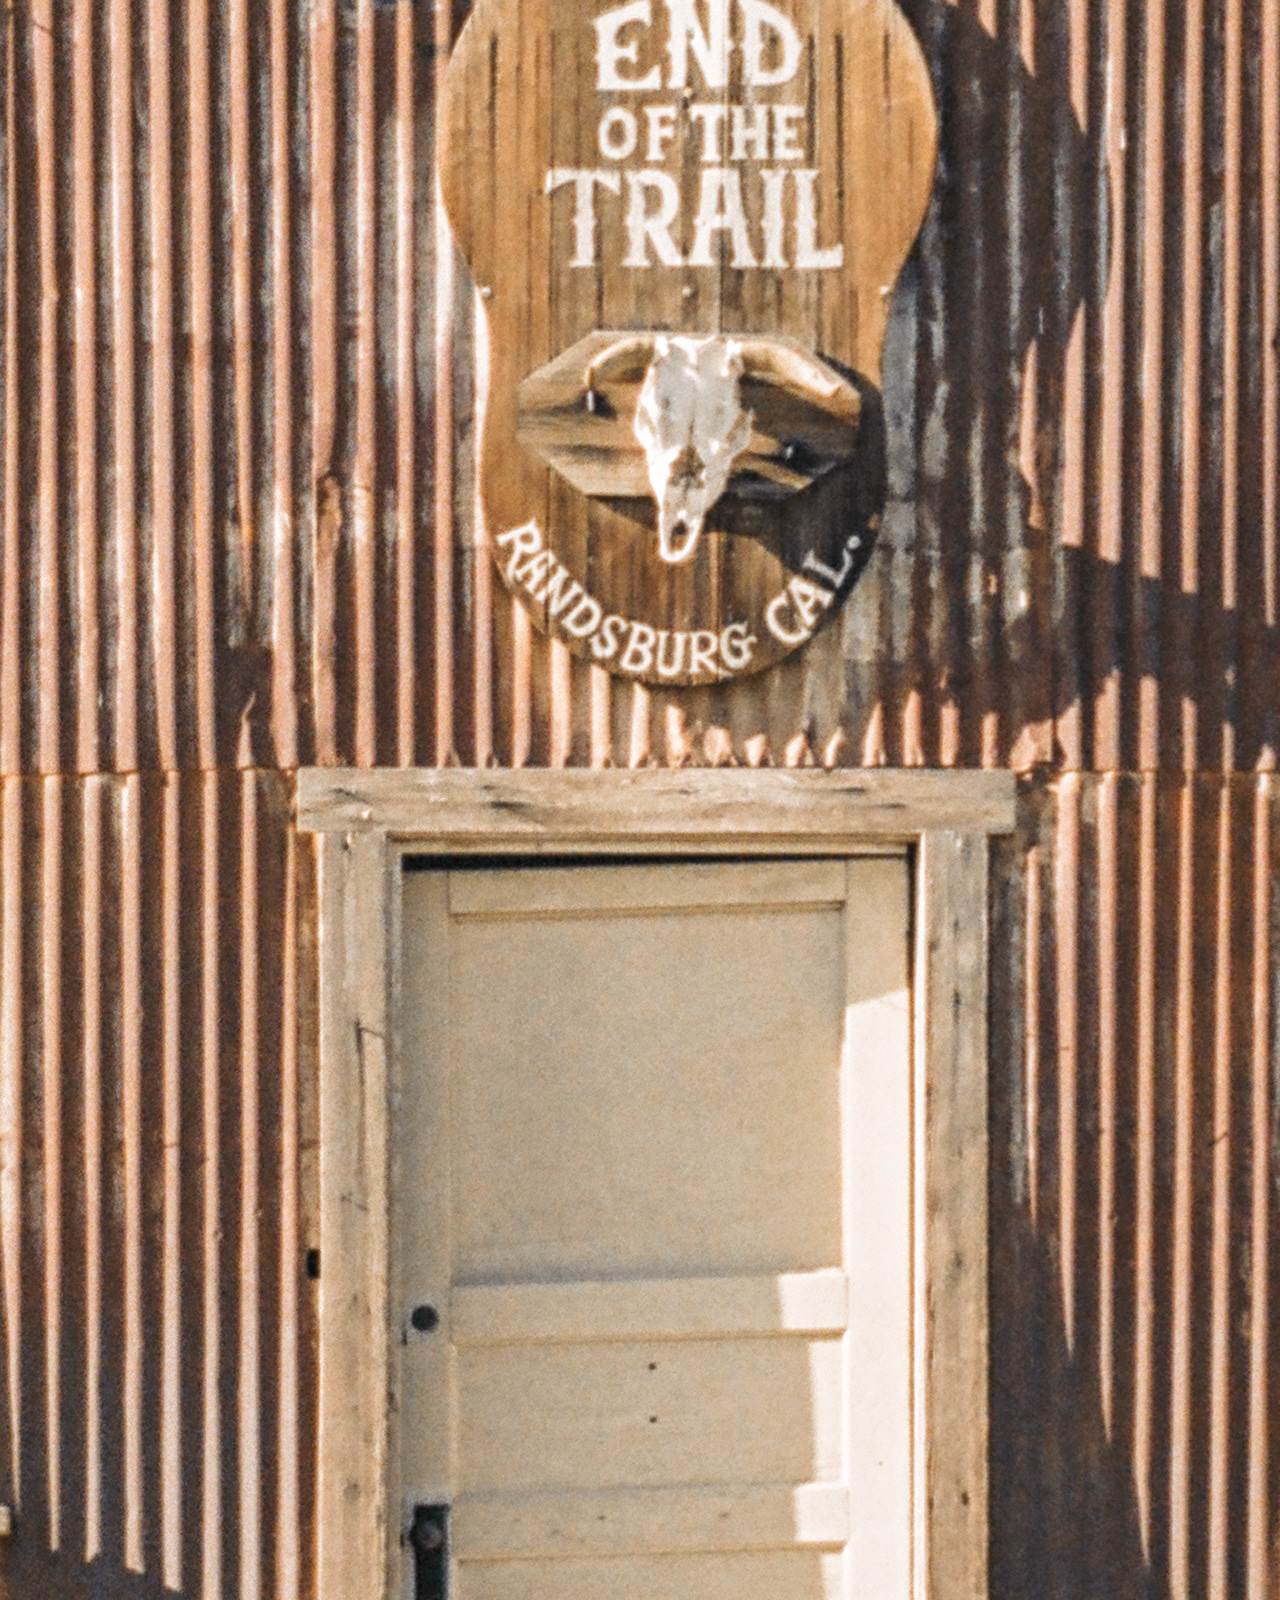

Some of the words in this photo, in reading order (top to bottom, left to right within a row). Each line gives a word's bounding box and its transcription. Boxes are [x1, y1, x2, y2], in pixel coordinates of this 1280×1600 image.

[597, 103, 678, 162] OF
[688, 103, 806, 163] THE
[544, 167, 844, 269] TRAIL
[496, 517, 757, 679] RANDSBURG
[764, 534, 863, 645] CAL.
